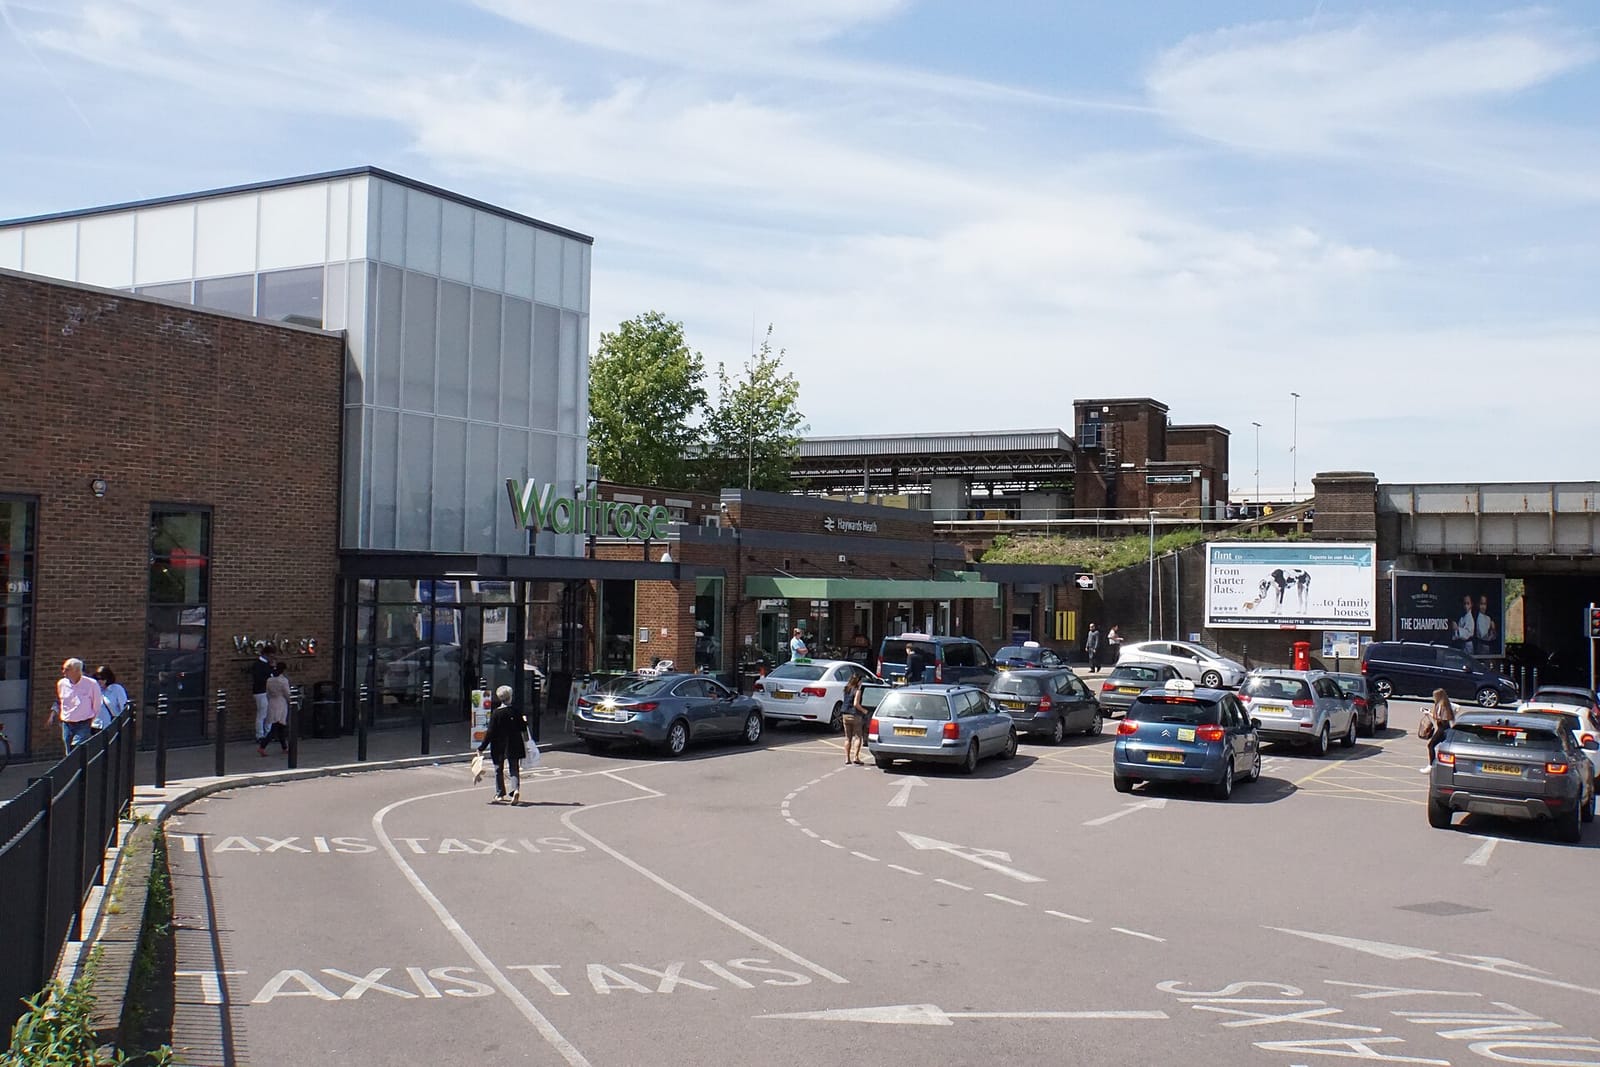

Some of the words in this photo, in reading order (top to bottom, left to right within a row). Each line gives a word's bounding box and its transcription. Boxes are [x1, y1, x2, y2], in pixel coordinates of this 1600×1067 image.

[505, 477, 670, 540] Waitrose
[837, 517, 862, 532] Haywards
[862, 520, 878, 532] Heath
[1214, 567, 1240, 575] From
[1214, 577, 1245, 585] starter
[1337, 597, 1370, 610] family
[1334, 607, 1369, 616] houses
[1400, 618, 1413, 630] THE
[1413, 618, 1449, 630] CHAMPIONS
[168, 834, 378, 854] TAXIS
[393, 837, 588, 854] TAXIS
[173, 964, 497, 1005] TAXIS
[507, 958, 813, 995] TAXIS
[1155, 979, 1452, 1067] AXIS
